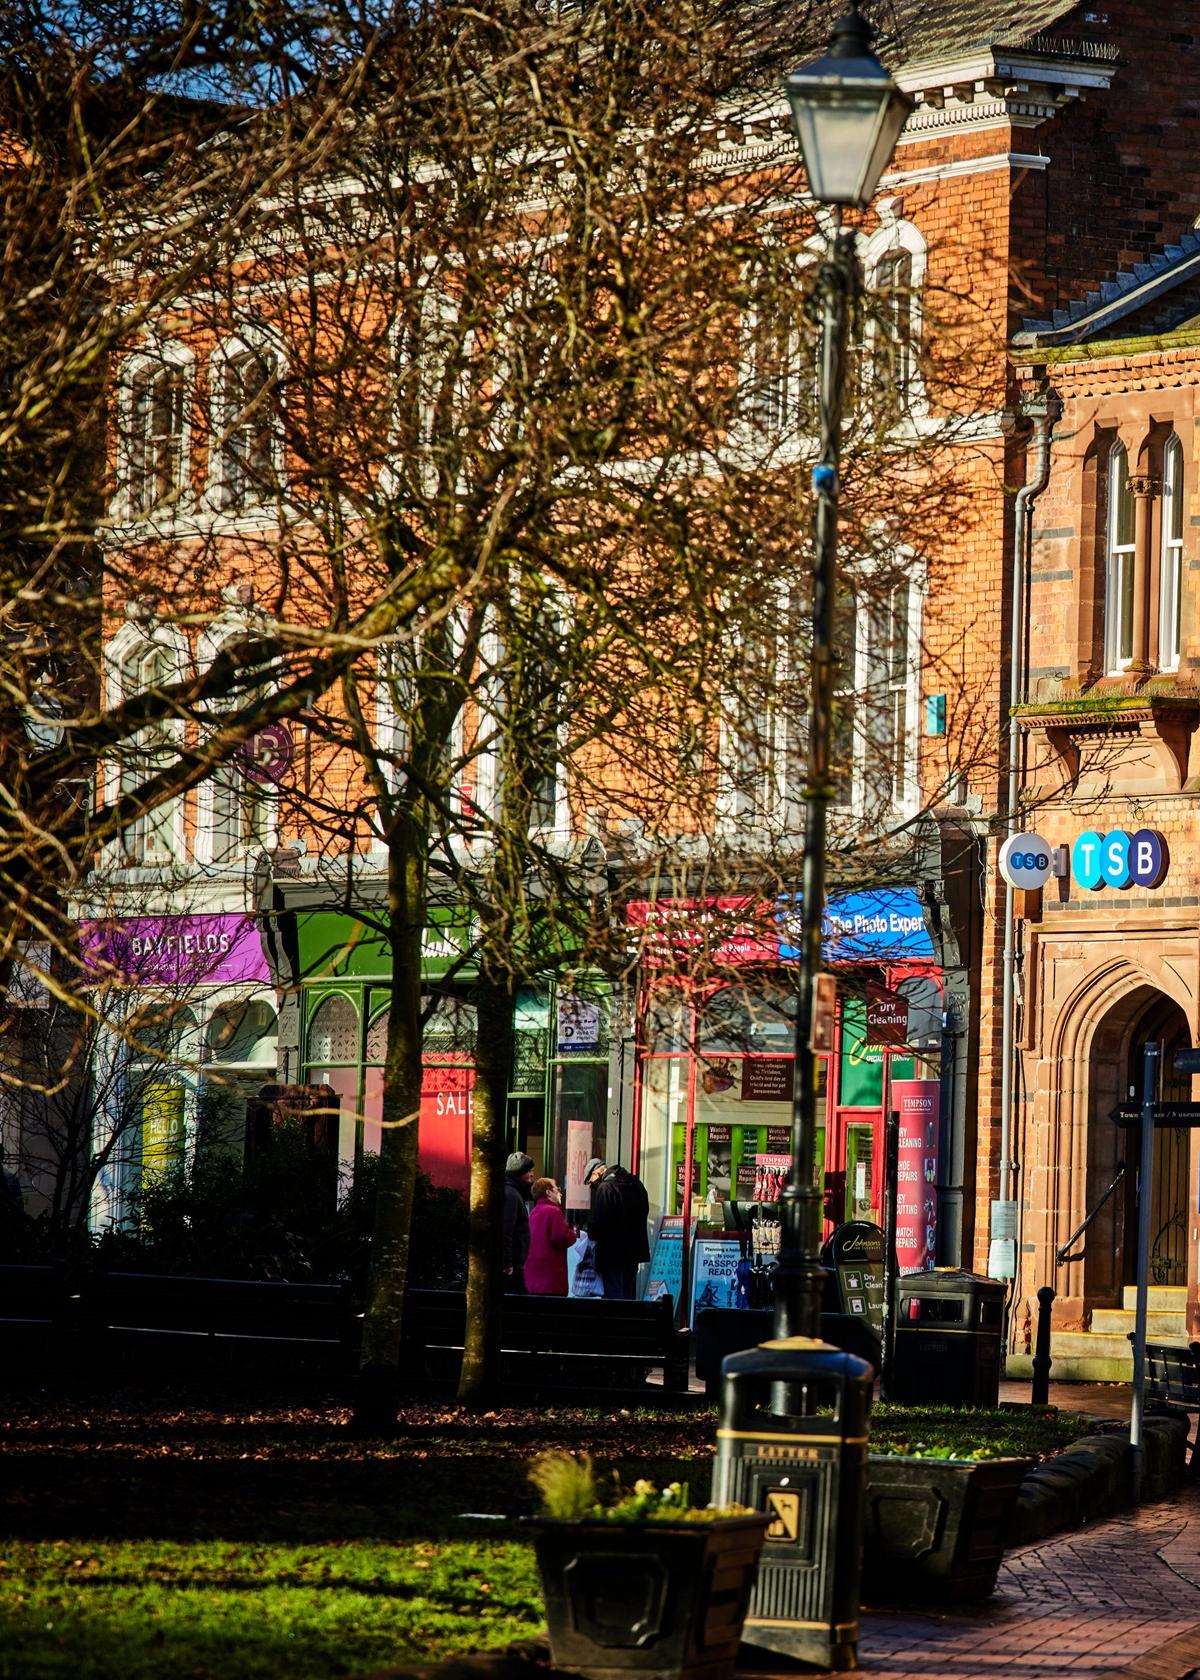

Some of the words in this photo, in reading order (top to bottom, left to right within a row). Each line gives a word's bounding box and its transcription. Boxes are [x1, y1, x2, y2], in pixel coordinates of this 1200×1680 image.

[1014, 855, 1046, 867] TSB
[1081, 841, 1153, 877] TSB
[830, 915, 851, 934] The
[854, 914, 887, 933] Photo
[890, 913, 927, 935] Exper
[132, 933, 229, 956] BAYFIELDS
[880, 1002, 896, 1014] Dry
[868, 1013, 907, 1026] Cleaning
[436, 1091, 474, 1116] SALE
[903, 1099, 932, 1108] TIMPSON
[899, 1127, 908, 1137] RY
[898, 1138, 922, 1148] LEANING
[703, 1259, 738, 1268] PASSPO
[865, 1281, 883, 1289] Clean
[758, 1445, 818, 1459] LITTER
